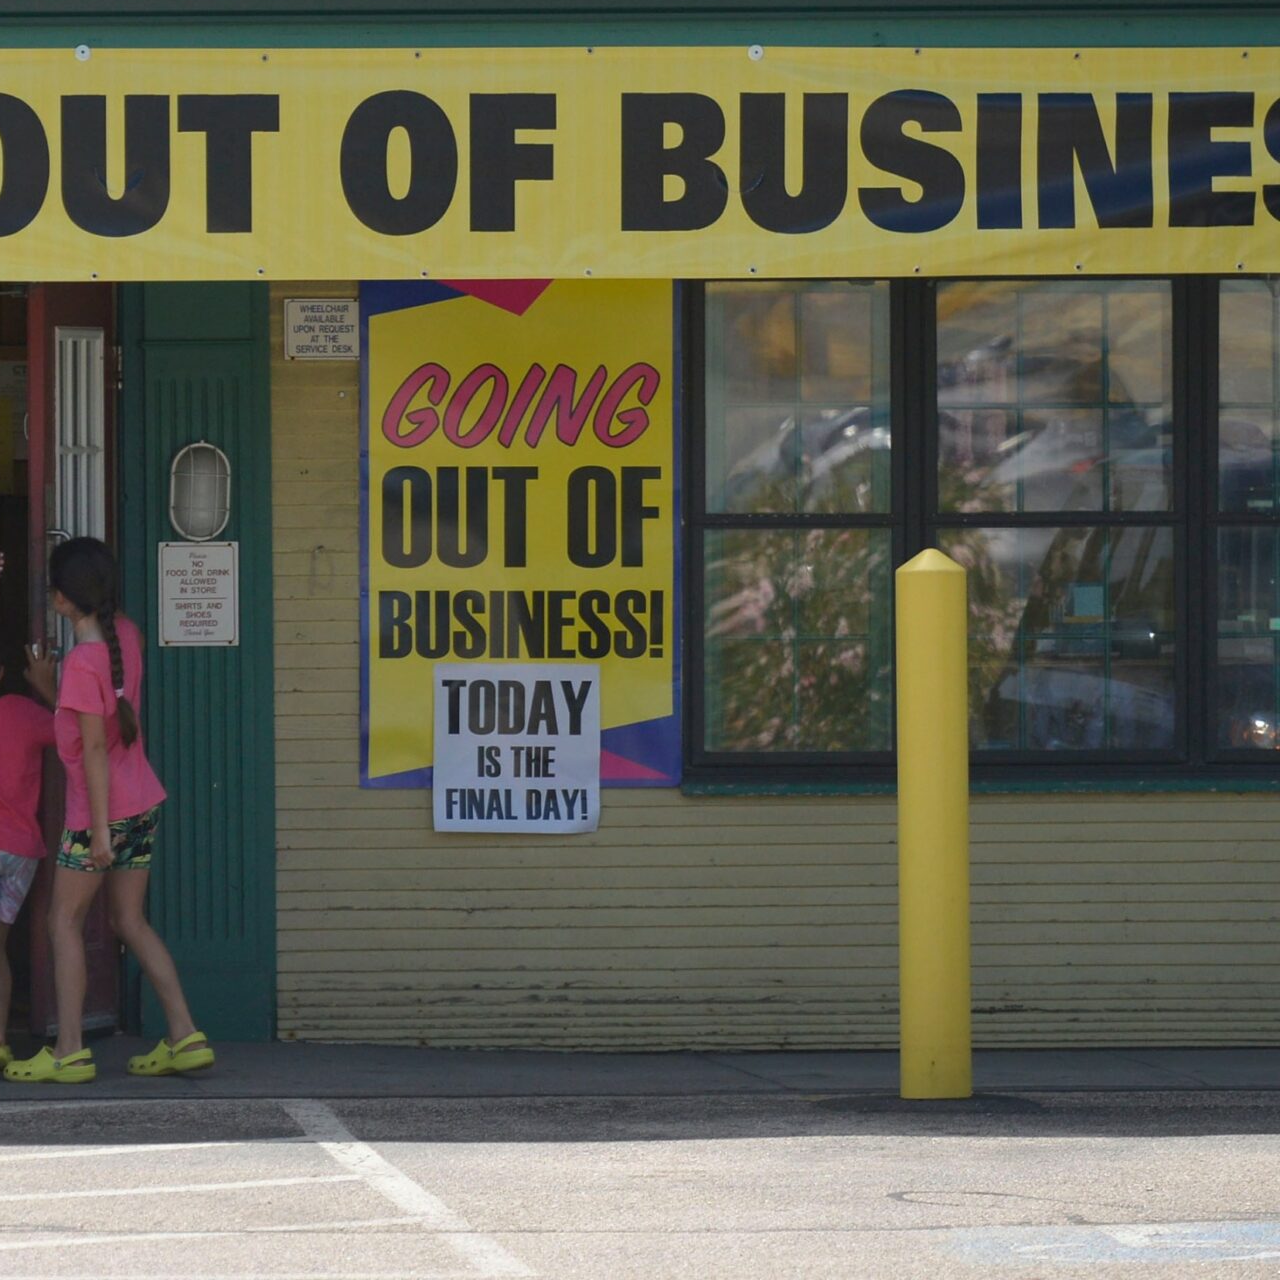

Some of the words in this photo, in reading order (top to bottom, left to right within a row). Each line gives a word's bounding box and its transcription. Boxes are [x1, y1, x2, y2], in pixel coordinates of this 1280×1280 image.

[339, 89, 557, 236] OF
[621, 88, 1280, 234] BUSINE
[299, 304, 349, 313] WHEELCHAIR
[293, 325, 315, 333] UPON
[319, 325, 355, 333] REQUEST
[304, 315, 345, 323] AVAILABLE
[296, 345, 328, 353] SERVICE
[332, 345, 353, 353] DESK
[310, 335, 320, 343] AT
[324, 335, 339, 343] THE
[381, 362, 661, 448] GOING
[381, 466, 538, 569] OUT
[567, 466, 661, 569] OF
[175, 602, 202, 610] SHIRTS
[179, 619, 218, 627] REQUIRED
[378, 590, 664, 659] BUSINESS!
[441, 679, 592, 736] TODAY
[477, 746, 508, 778] IS
[511, 746, 556, 778] THE
[445, 788, 518, 821] FINAL
[525, 787, 589, 821] DAY!
